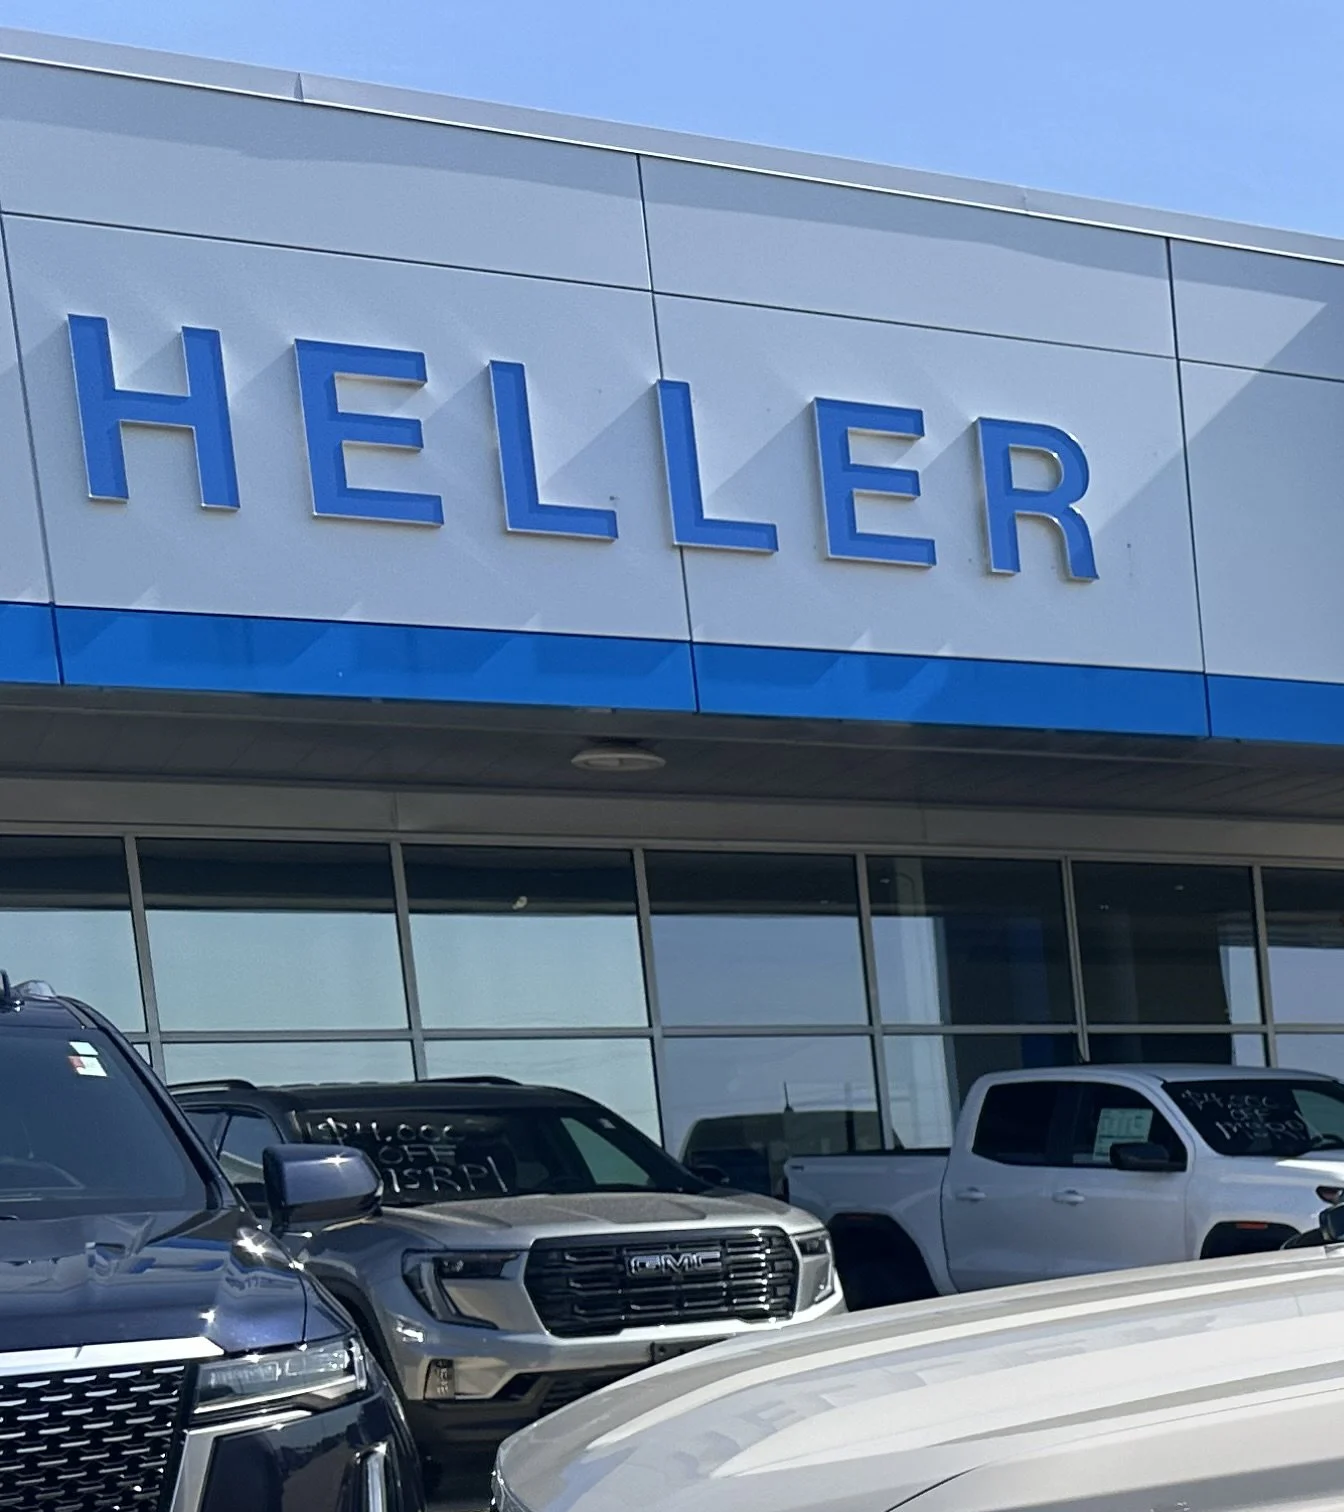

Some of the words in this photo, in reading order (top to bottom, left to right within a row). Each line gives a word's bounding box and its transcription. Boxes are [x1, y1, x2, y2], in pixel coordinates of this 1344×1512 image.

[67, 312, 1099, 581] HELLER
[378, 1143, 457, 1165] OFF
[627, 1250, 723, 1277] GMC
